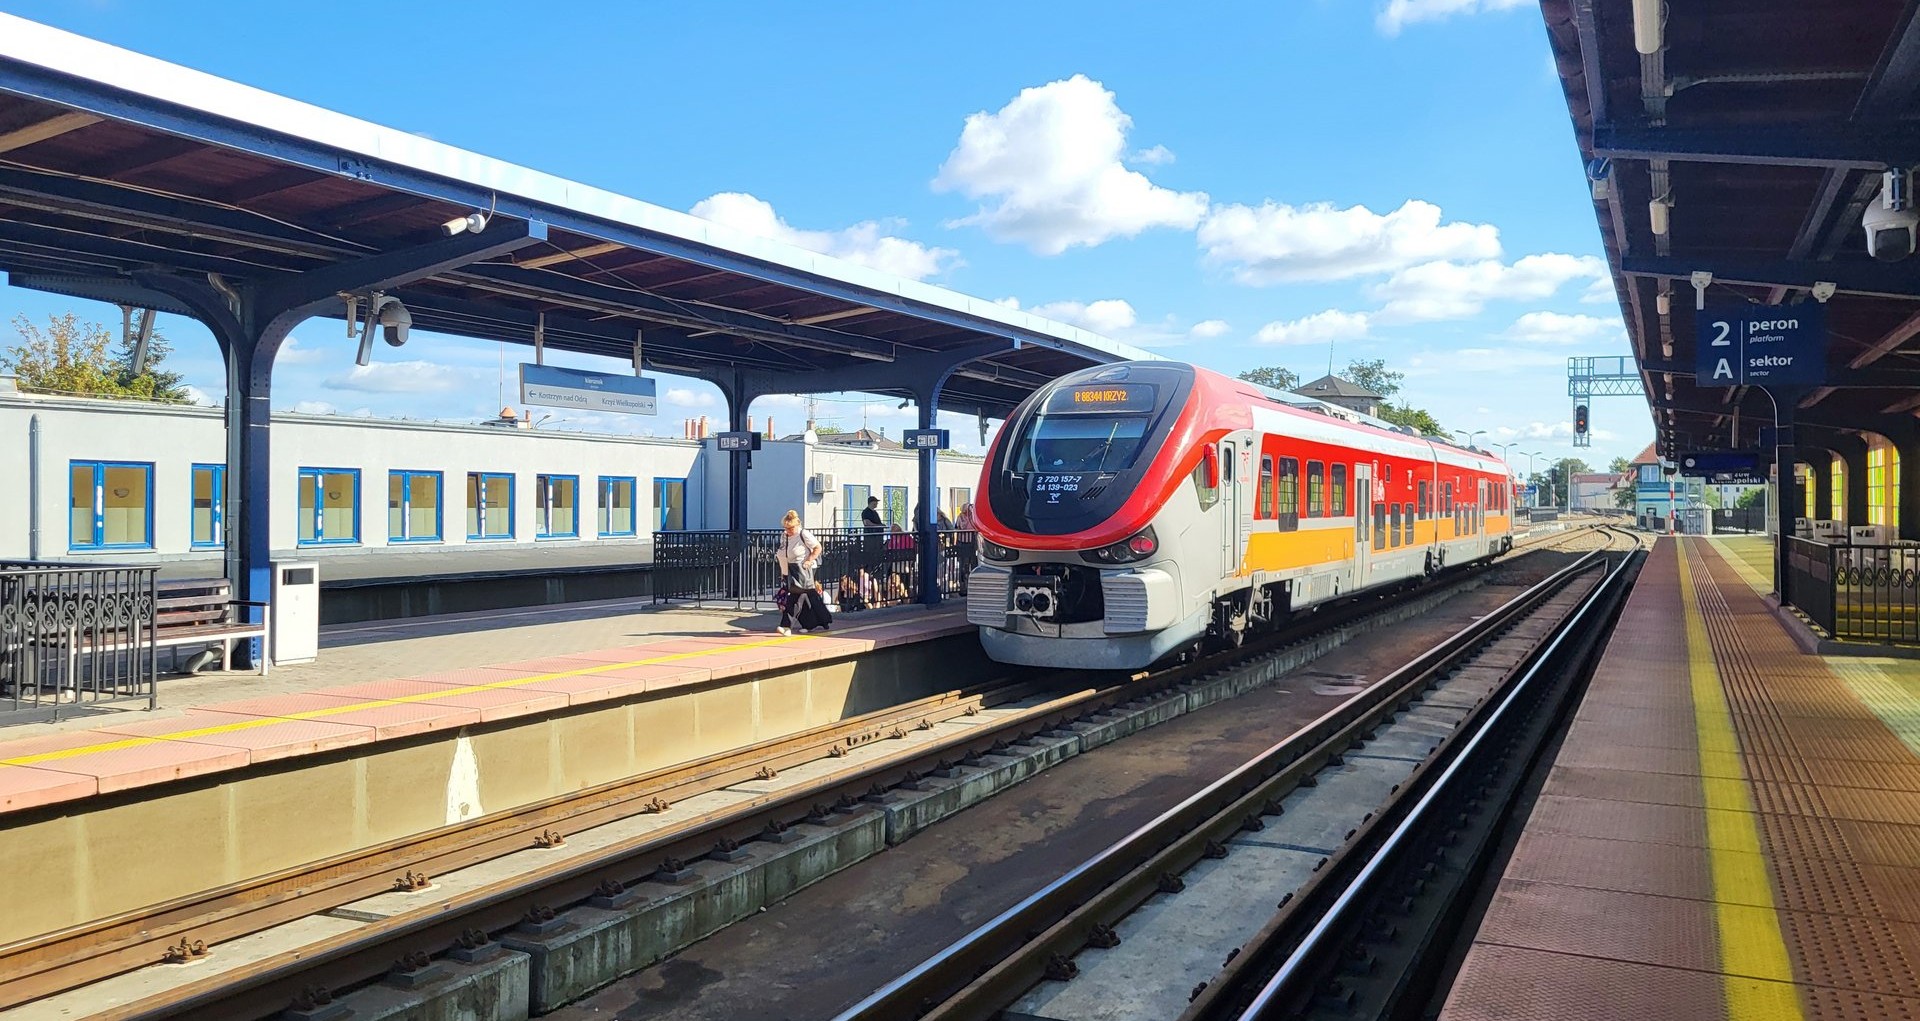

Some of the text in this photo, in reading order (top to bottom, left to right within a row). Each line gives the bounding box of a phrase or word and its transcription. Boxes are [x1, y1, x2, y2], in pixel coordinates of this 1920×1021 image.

[1711, 319, 1798, 347] 2 peron
[1749, 335, 1784, 344] platform
[1712, 355, 1794, 379] A sektor
[538, 392, 563, 402] Kostrzyn
[616, 398, 646, 409] Wielkopolski
